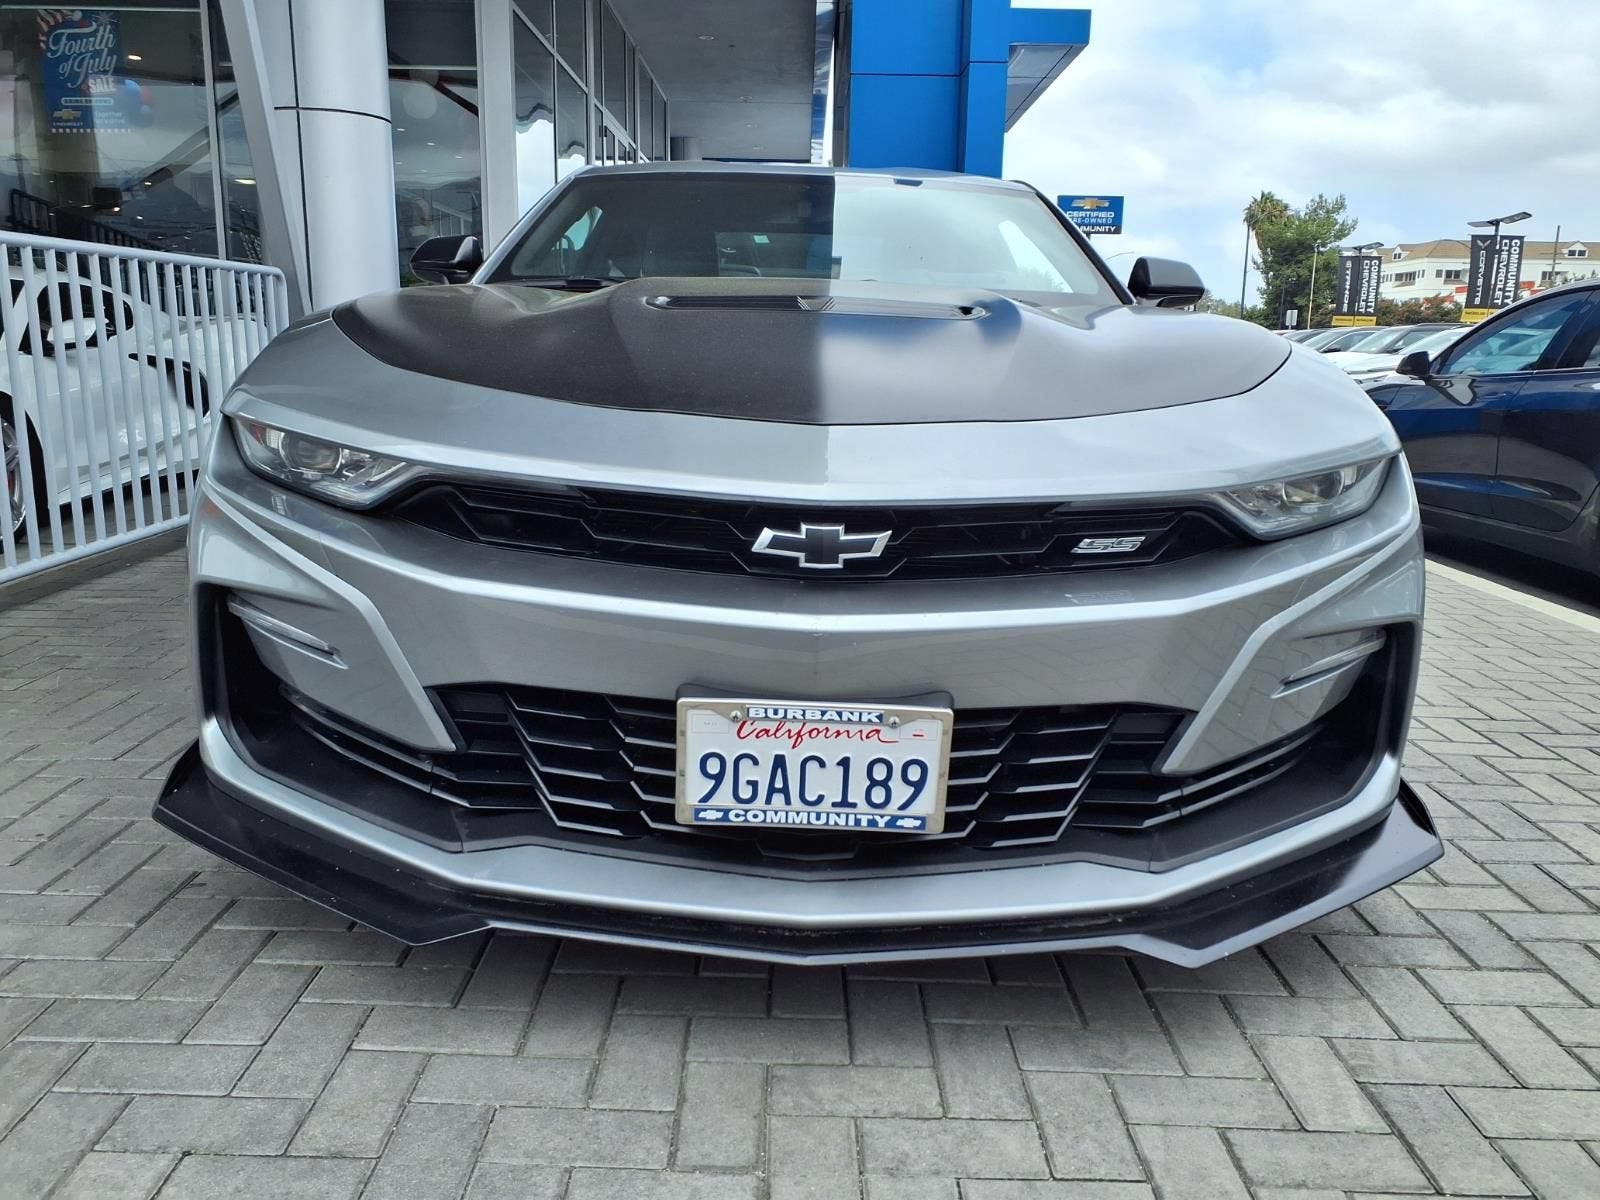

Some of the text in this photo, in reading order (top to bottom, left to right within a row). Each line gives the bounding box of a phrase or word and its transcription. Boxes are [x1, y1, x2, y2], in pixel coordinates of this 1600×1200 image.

[47, 21, 116, 58] Fourth
[58, 48, 117, 88] of July
[88, 75, 116, 93] SALE
[1359, 260, 1370, 314] CHEVROLET
[1367, 260, 1379, 313] COMMUNITY
[1474, 250, 1486, 305] CORVETTE
[1494, 239, 1509, 305] CHEVROLET
[1504, 239, 1520, 305] COMMUNITY
[1070, 536, 1146, 554] SS
[736, 719, 899, 749] California
[749, 706, 881, 723] BURBANK
[698, 751, 929, 811] 9GAC189
[728, 809, 891, 828] COMMUNITY
